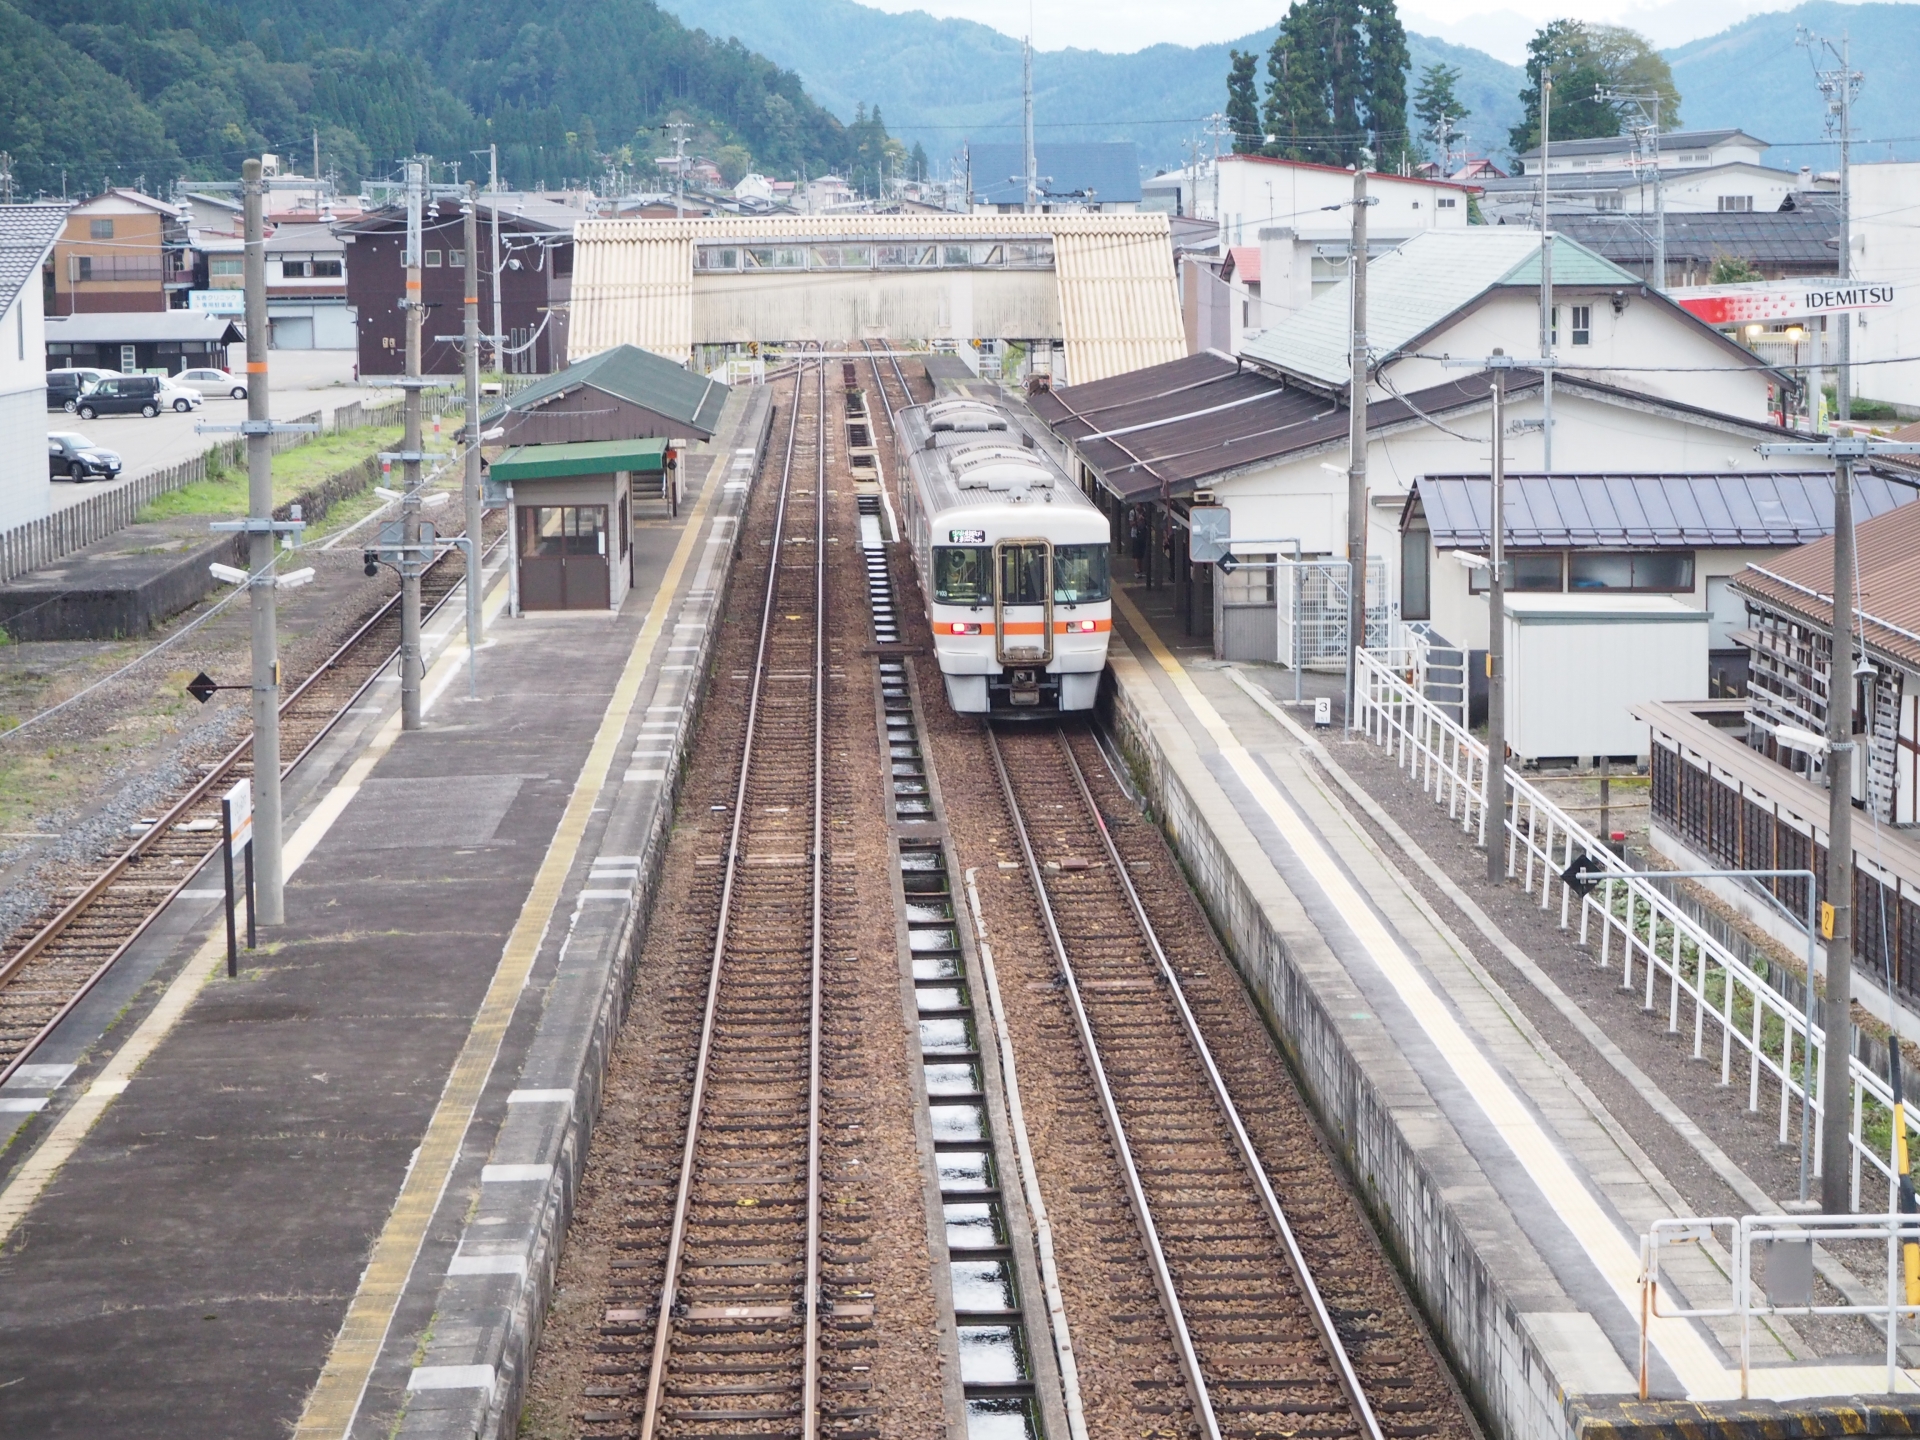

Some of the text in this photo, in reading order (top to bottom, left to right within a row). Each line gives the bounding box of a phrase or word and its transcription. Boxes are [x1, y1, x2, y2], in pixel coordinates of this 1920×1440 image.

[1806, 287, 1894, 308] IDEMITSU
[1319, 702, 1328, 712] 3
[1825, 911, 1830, 931] 2
